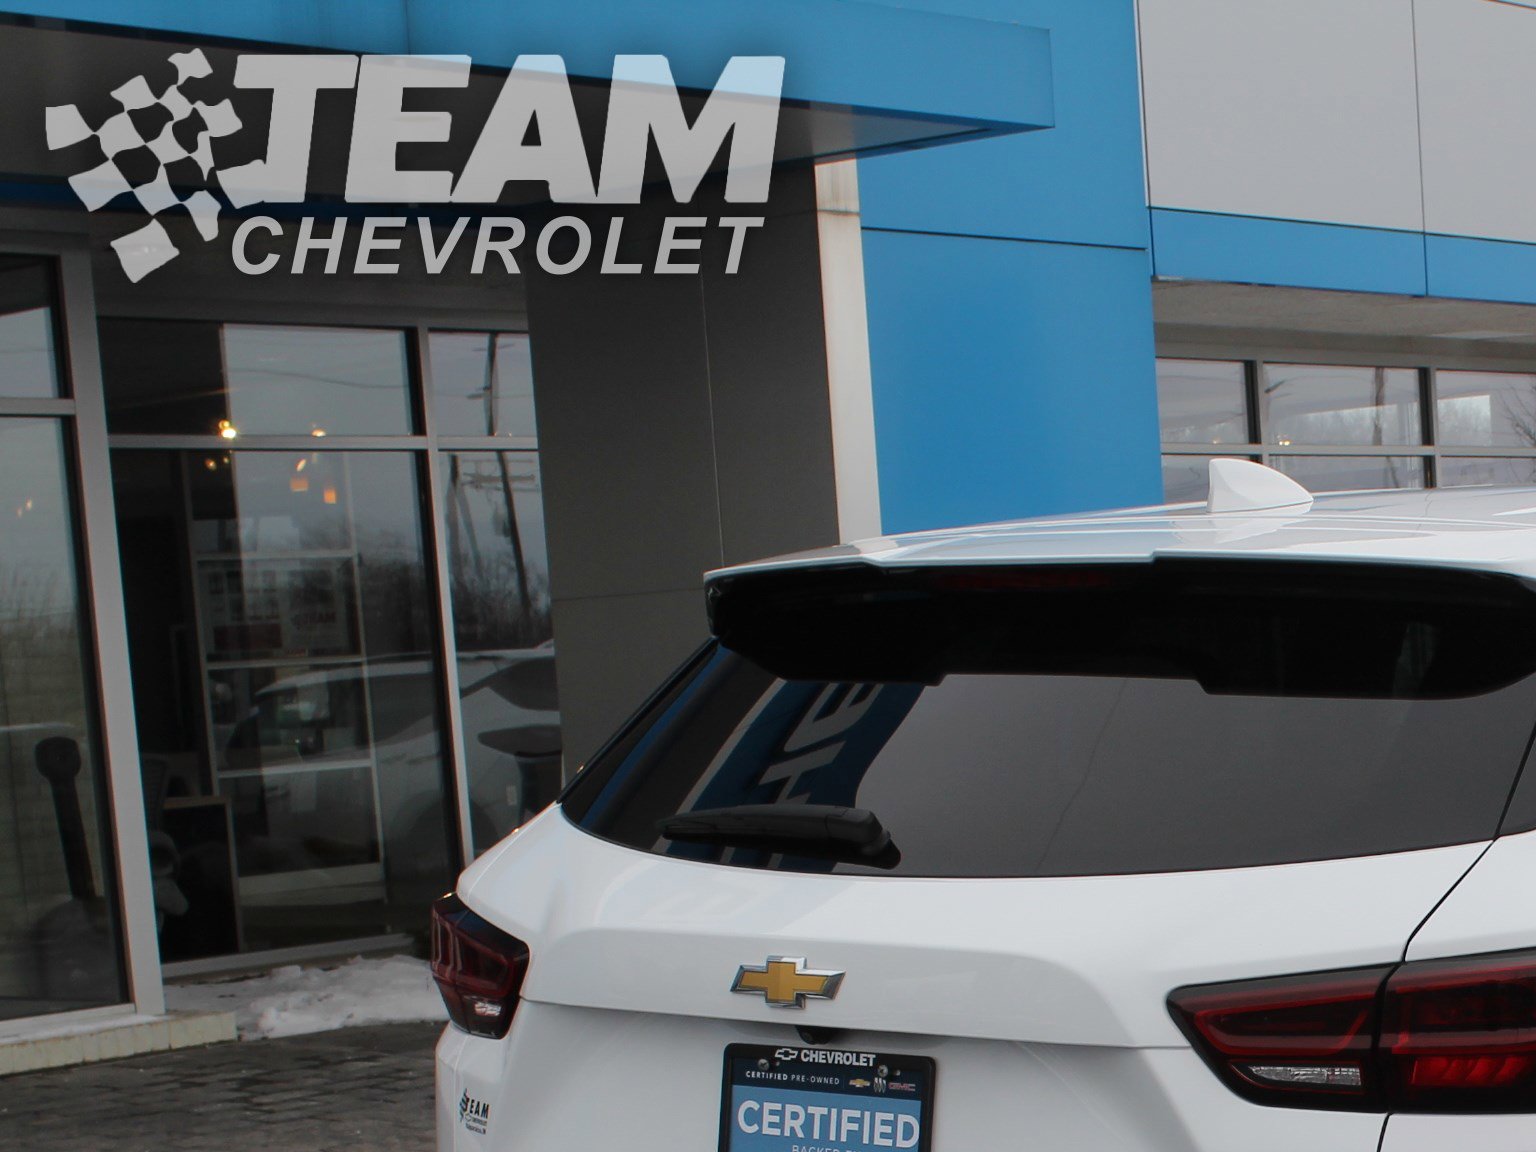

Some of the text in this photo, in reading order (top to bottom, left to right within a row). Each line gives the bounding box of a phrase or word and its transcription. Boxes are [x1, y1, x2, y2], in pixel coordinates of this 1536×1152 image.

[800, 1049, 876, 1067] CHEVROLET
[745, 1070, 840, 1085] CERTIFIED PRE-OWNED
[737, 1099, 920, 1149] CERTIFIED
